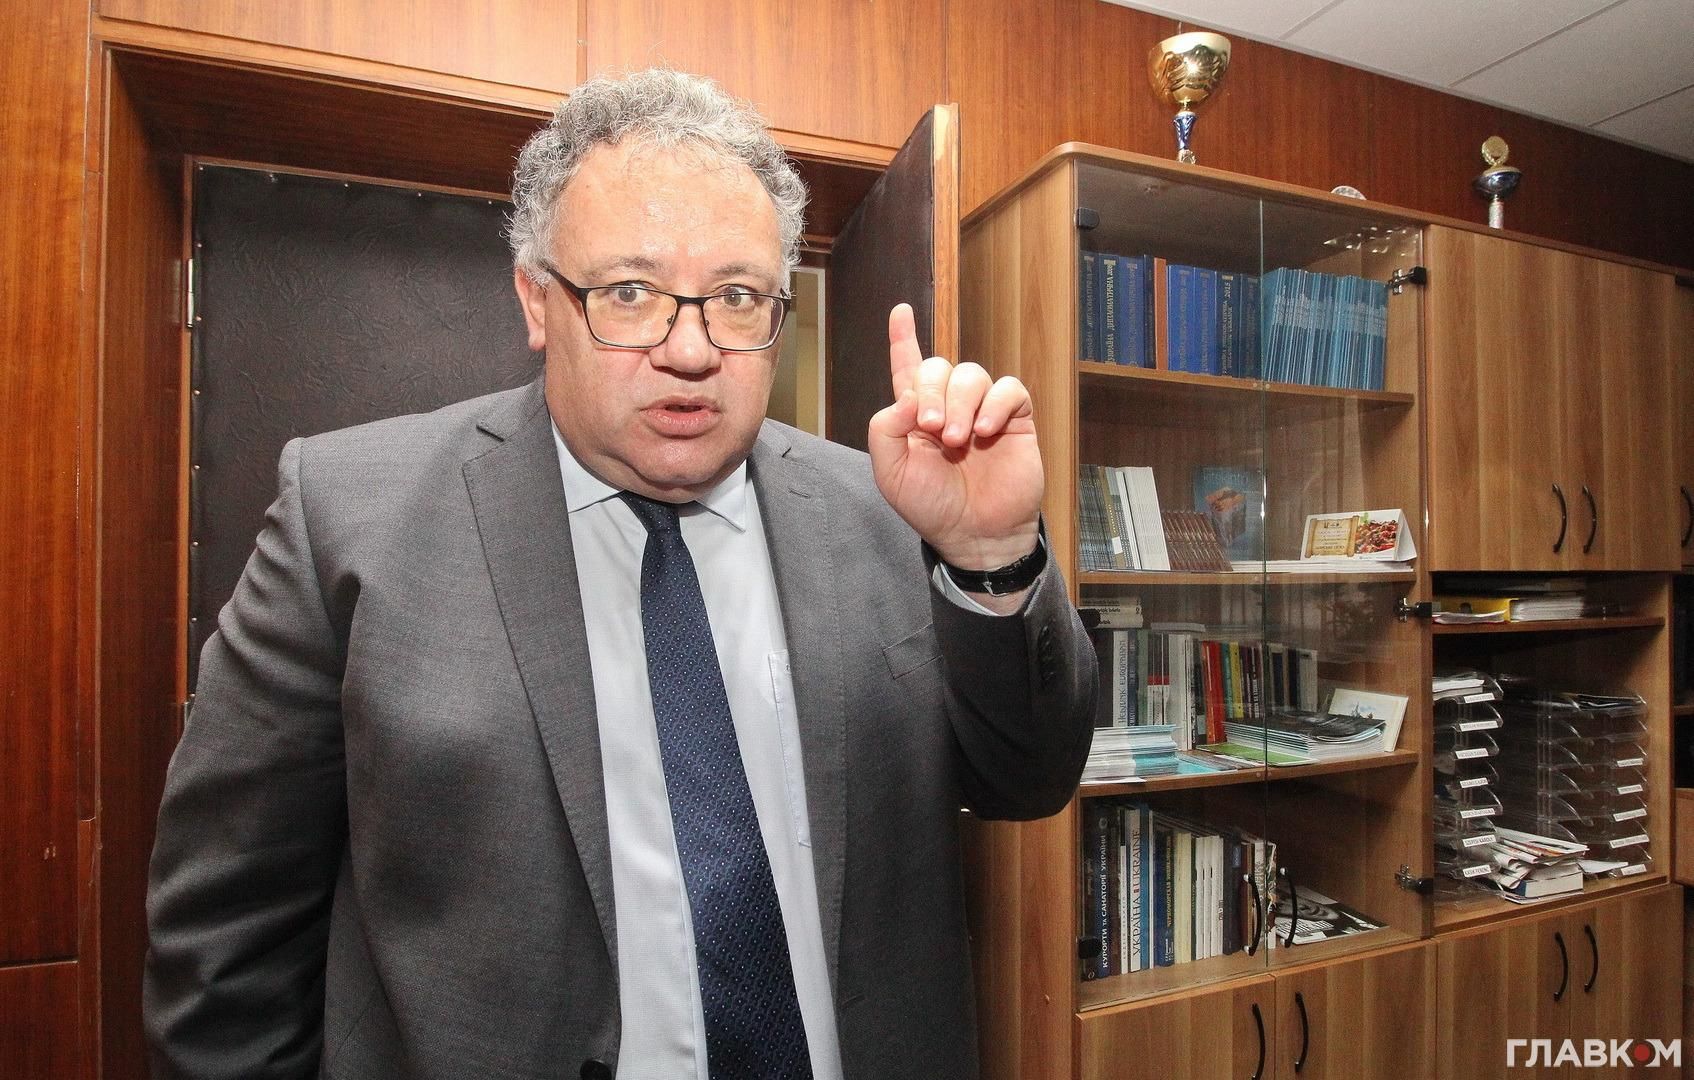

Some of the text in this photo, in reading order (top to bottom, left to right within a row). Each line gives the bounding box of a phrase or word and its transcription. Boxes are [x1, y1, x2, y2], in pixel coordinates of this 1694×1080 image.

[1098, 835, 1107, 871] УКРАЇНИ
[1131, 827, 1141, 887] UKRAINE
[1099, 874, 1108, 917] САНАТОРІЇ
[1130, 894, 1141, 956] УКРАЇНА
[1101, 928, 1109, 968] КУРОРТИ
